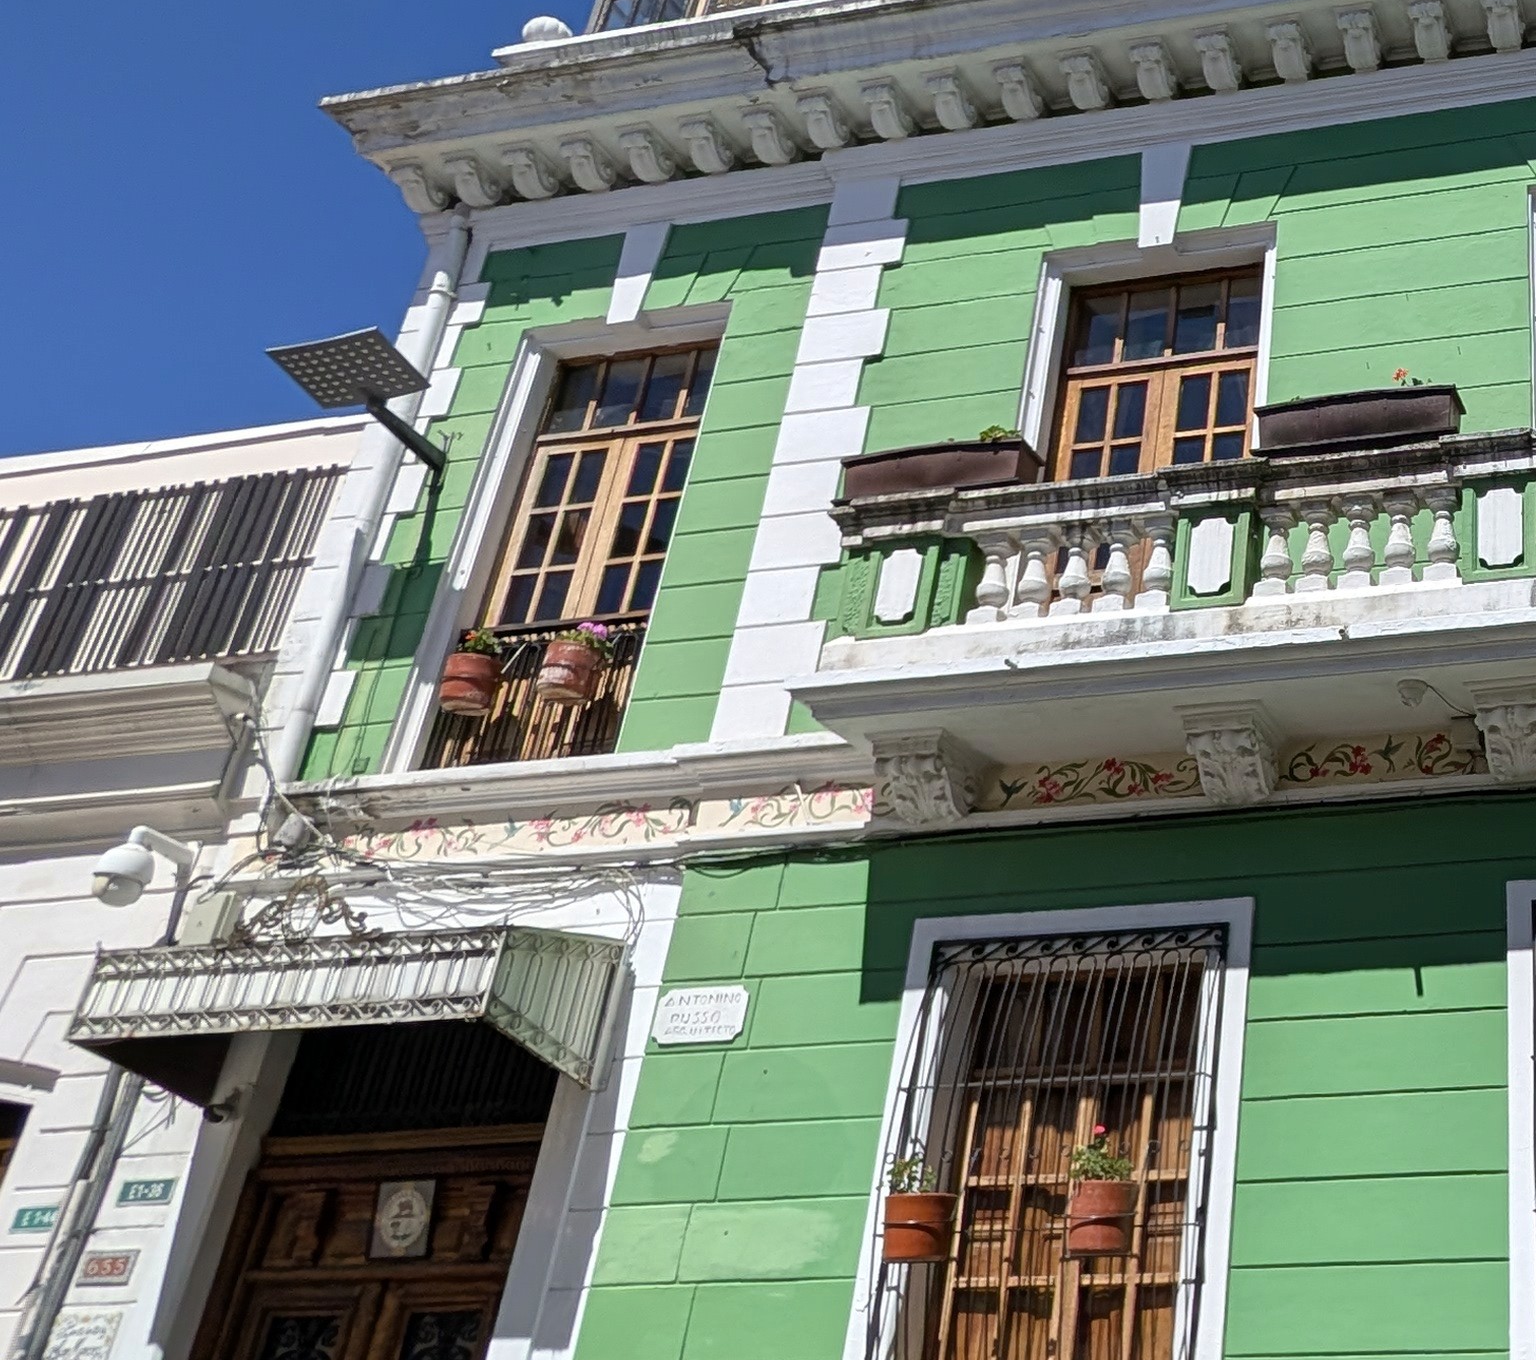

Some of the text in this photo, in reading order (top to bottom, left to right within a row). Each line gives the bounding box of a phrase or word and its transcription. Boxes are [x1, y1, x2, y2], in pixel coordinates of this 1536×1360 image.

[665, 993, 741, 1007] ANTONINO
[670, 1011, 721, 1024] RUSSO
[87, 1259, 126, 1275] 655
